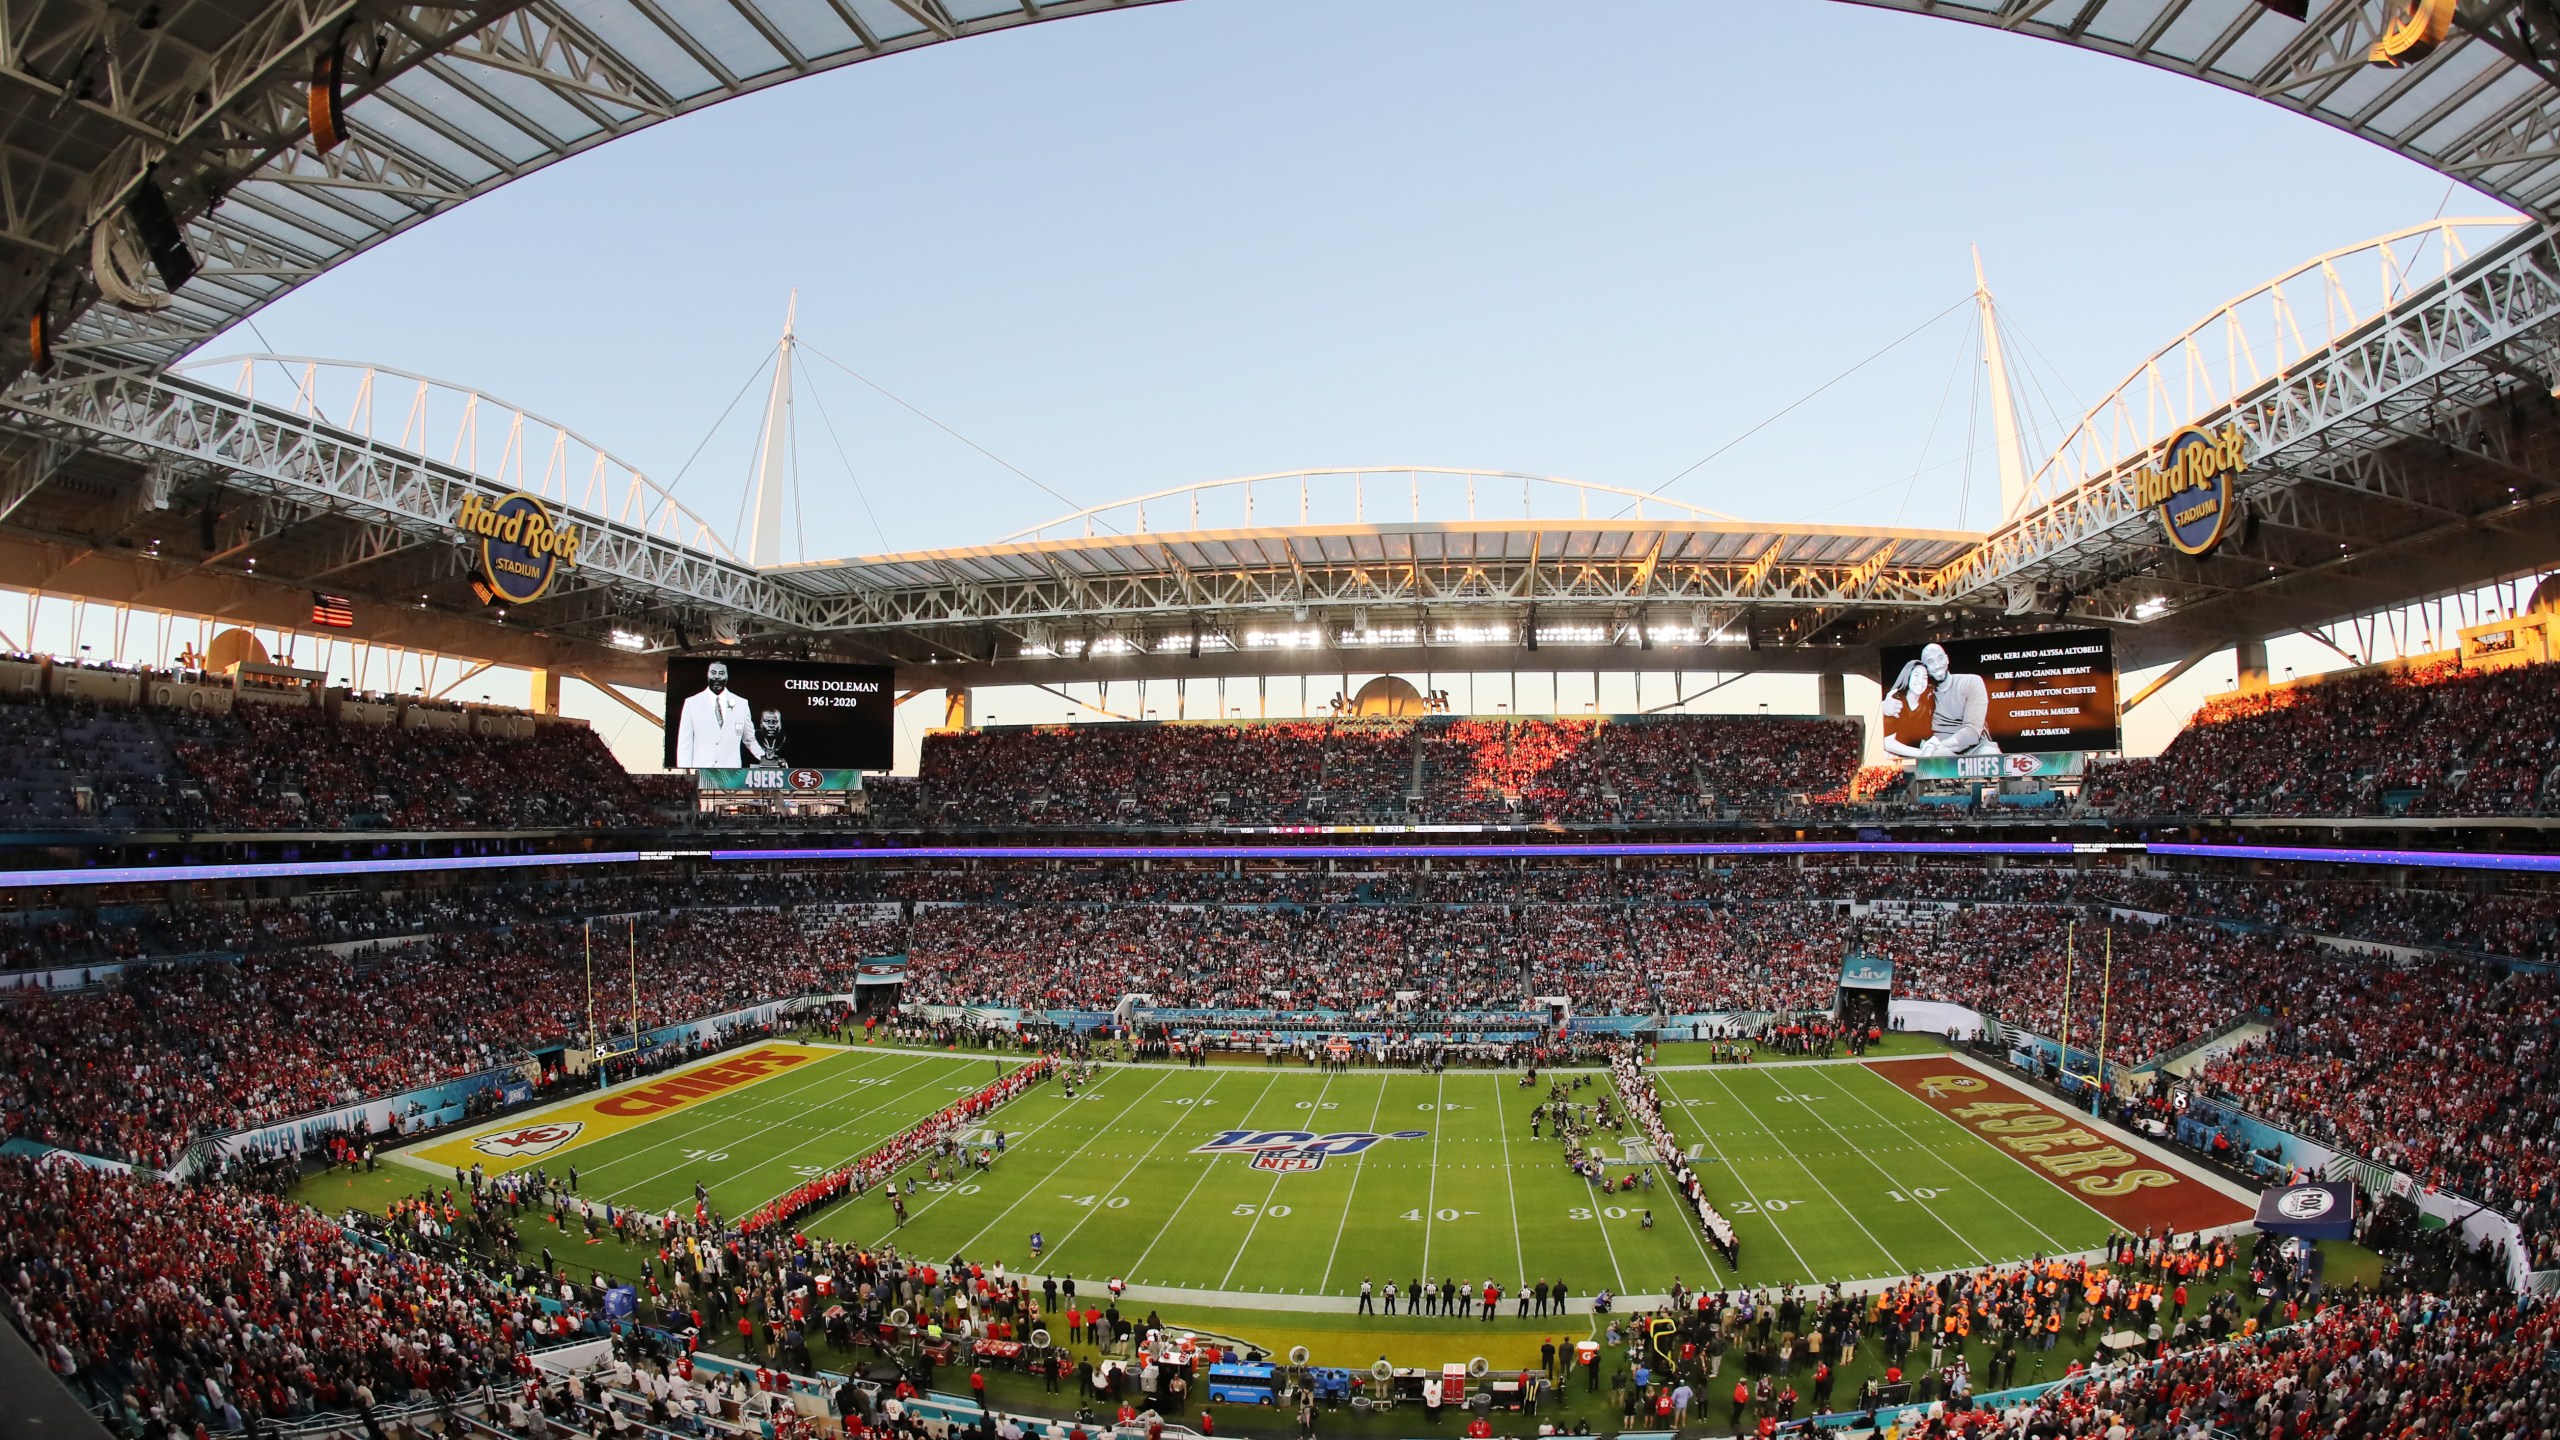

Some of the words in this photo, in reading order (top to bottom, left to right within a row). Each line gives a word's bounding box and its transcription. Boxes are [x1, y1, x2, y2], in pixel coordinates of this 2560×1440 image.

[2134, 448, 2188, 511] Hard
[2186, 422, 2248, 490] Rock
[2174, 499, 2218, 527] STADIUM
[457, 492, 526, 543] Hard
[523, 512, 580, 567] Rock
[495, 558, 540, 579] STADIUM
[1980, 654, 2003, 663] JOHN,
[2003, 652, 2020, 660] KERI
[2021, 650, 2038, 659] AND
[2039, 648, 2064, 657] ALYSSA
[2064, 645, 2103, 655] ALTOBELLI
[1994, 671, 2015, 680] KOBE
[2015, 670, 2031, 678] AND
[2031, 669, 2062, 677] GIANNA
[2062, 666, 2092, 675] BRYANT
[784, 679, 820, 691] CHRIS
[822, 681, 879, 692] DOLEMAN
[1991, 691, 2015, 700] SARAH
[2015, 690, 2033, 698] AND
[2033, 688, 2062, 697] PAYTON
[2062, 686, 2097, 695] CHESTER
[807, 696, 857, 707] 1961-2020
[2009, 709, 2049, 718] CHRISTINA
[2050, 707, 2080, 716] MAUSER
[2020, 729, 2036, 737] ARA
[2036, 728, 2070, 736] ZOBAYAN
[1957, 757, 1999, 777] CHIEFS
[745, 770, 784, 788] 49ERS
[596, 1045, 606, 1058] 25
[594, 1050, 808, 1117] CHIEFS
[2175, 1092, 2186, 1109] 25
[1950, 1102, 2180, 1196] 49ERS
[1257, 1157, 1315, 1171] NFL
[1073, 1195, 1131, 1209] 40
[1885, 1187, 1937, 1203] 10
[1730, 1200, 1789, 1214] 20
[2298, 1194, 2323, 1212] FOX
[1231, 1203, 1292, 1218] 50
[1400, 1208, 1460, 1221] 40
[1569, 1207, 1628, 1220] 30
[817, 1284, 825, 1292] G
[1582, 1352, 1591, 1360] G
